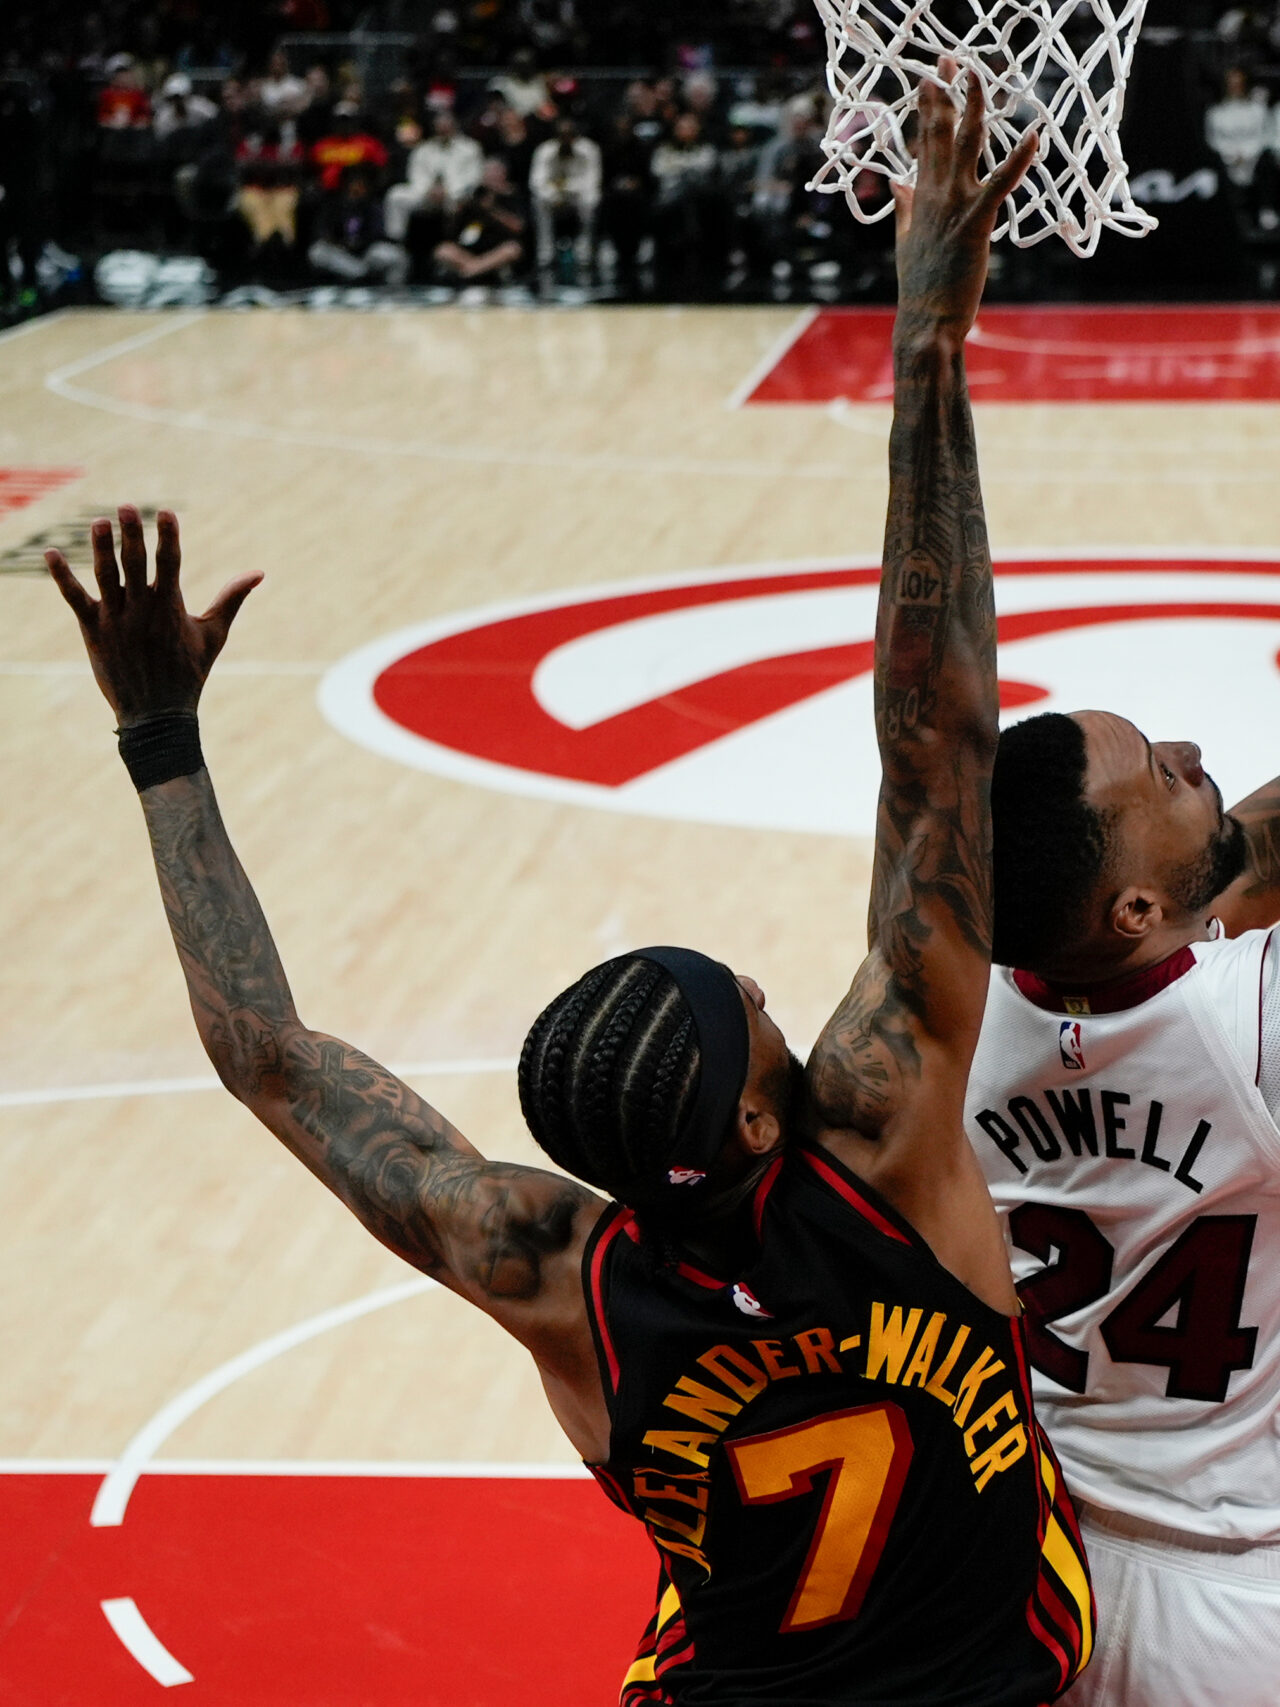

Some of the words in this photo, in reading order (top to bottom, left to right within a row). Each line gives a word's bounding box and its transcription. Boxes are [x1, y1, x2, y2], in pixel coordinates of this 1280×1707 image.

[975, 1088, 1212, 1194] POWELL
[1008, 1201, 1259, 1403] 24
[724, 1400, 915, 1634] 7
